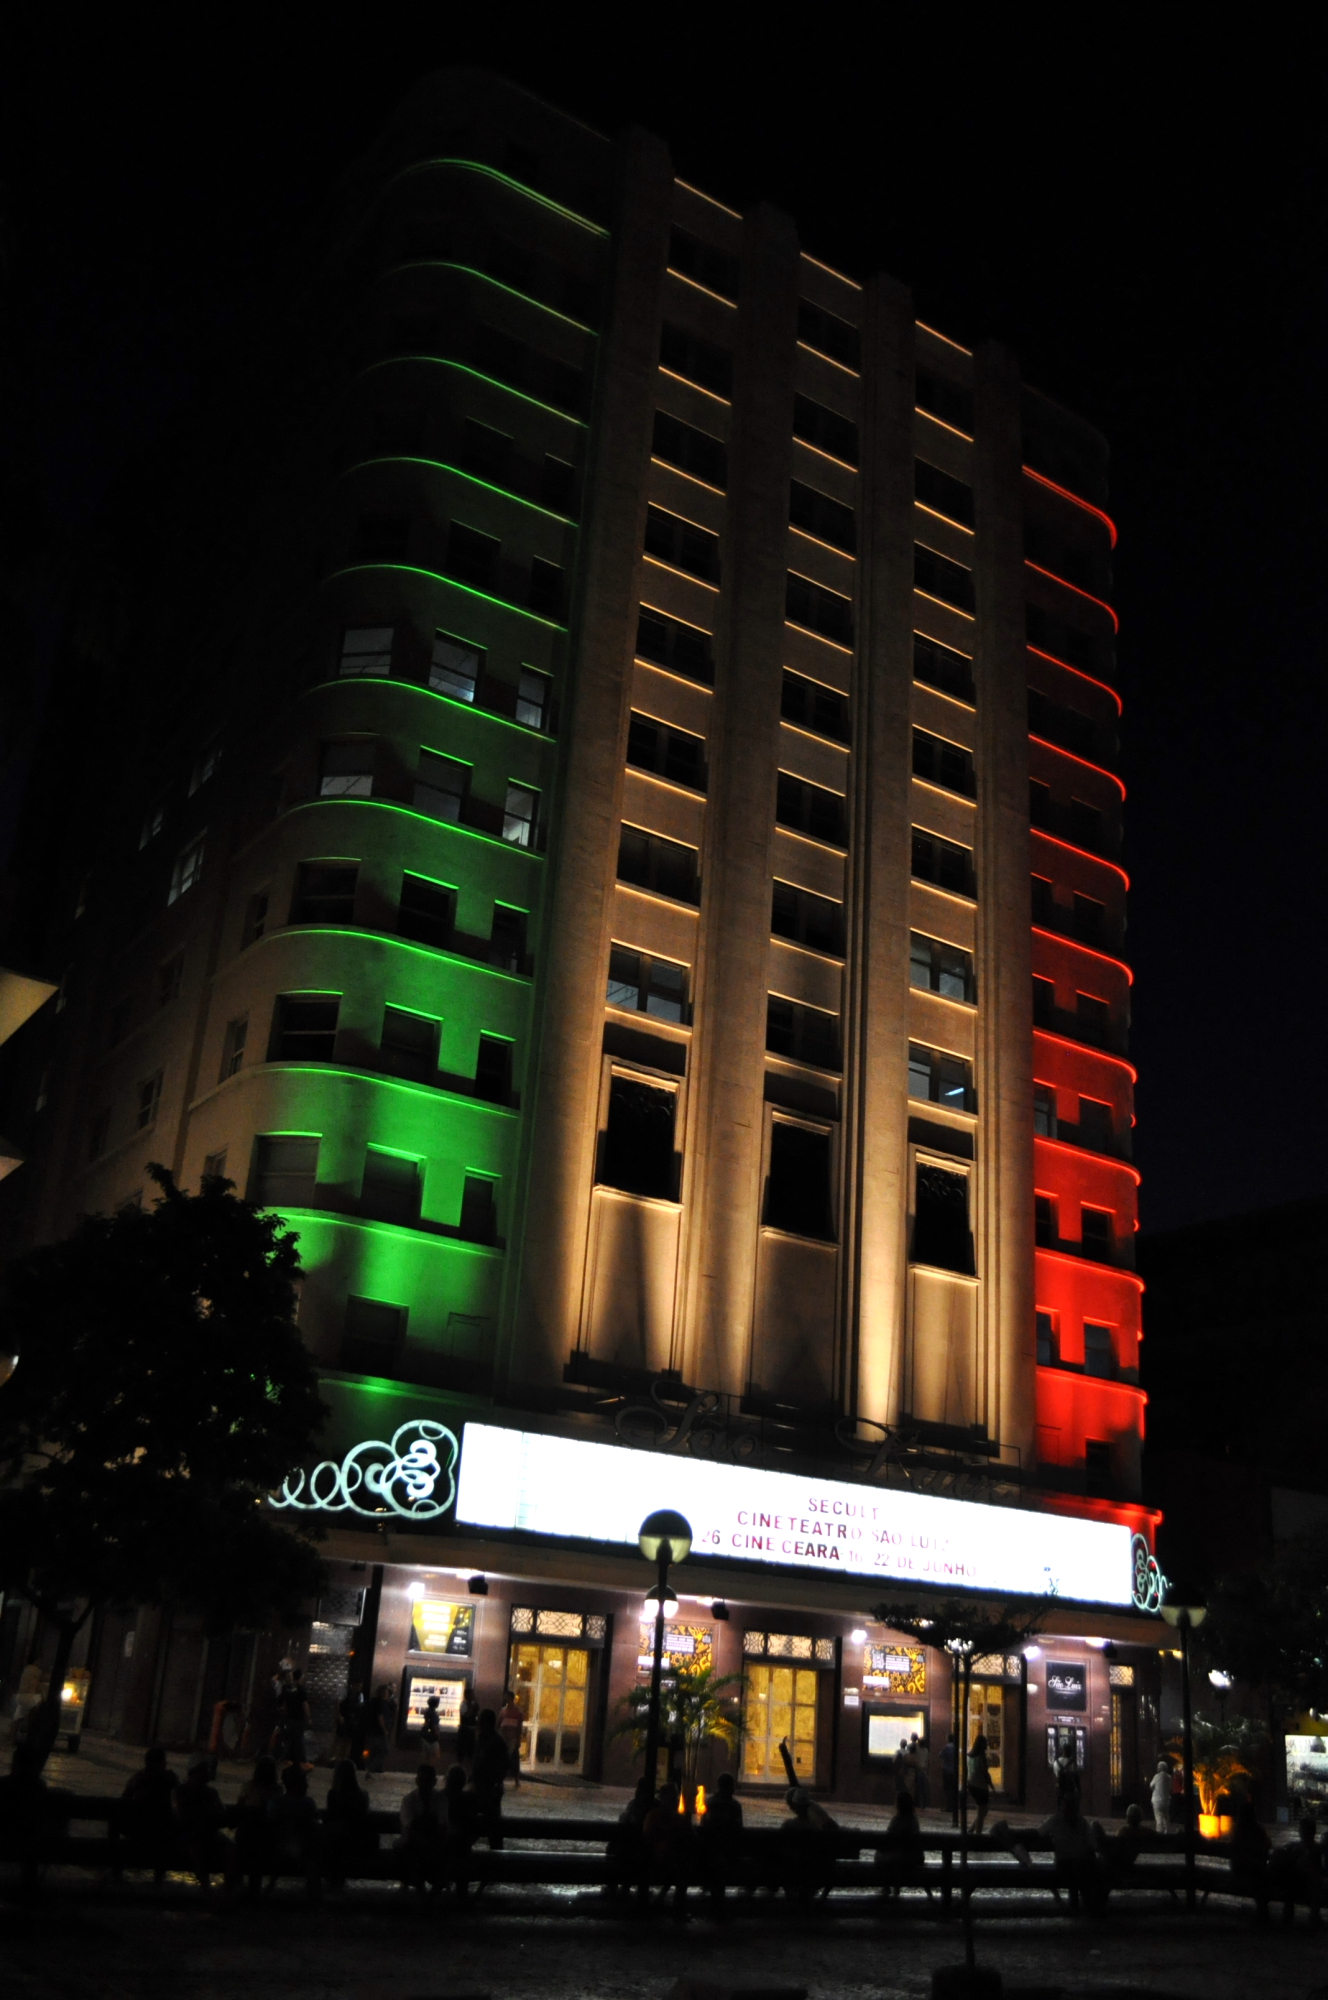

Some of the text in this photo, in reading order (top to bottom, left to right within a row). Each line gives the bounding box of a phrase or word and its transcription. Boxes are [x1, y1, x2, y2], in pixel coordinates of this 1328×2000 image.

[808, 1497, 879, 1520] SECULT
[737, 1510, 862, 1540] CINETEATRO
[701, 1529, 721, 1545] 26
[731, 1533, 775, 1551] CINE
[781, 1540, 840, 1561] CEARA
[873, 1552, 890, 1567] 22
[897, 1555, 915, 1570] DE
[923, 1561, 976, 1577] JUNHO
